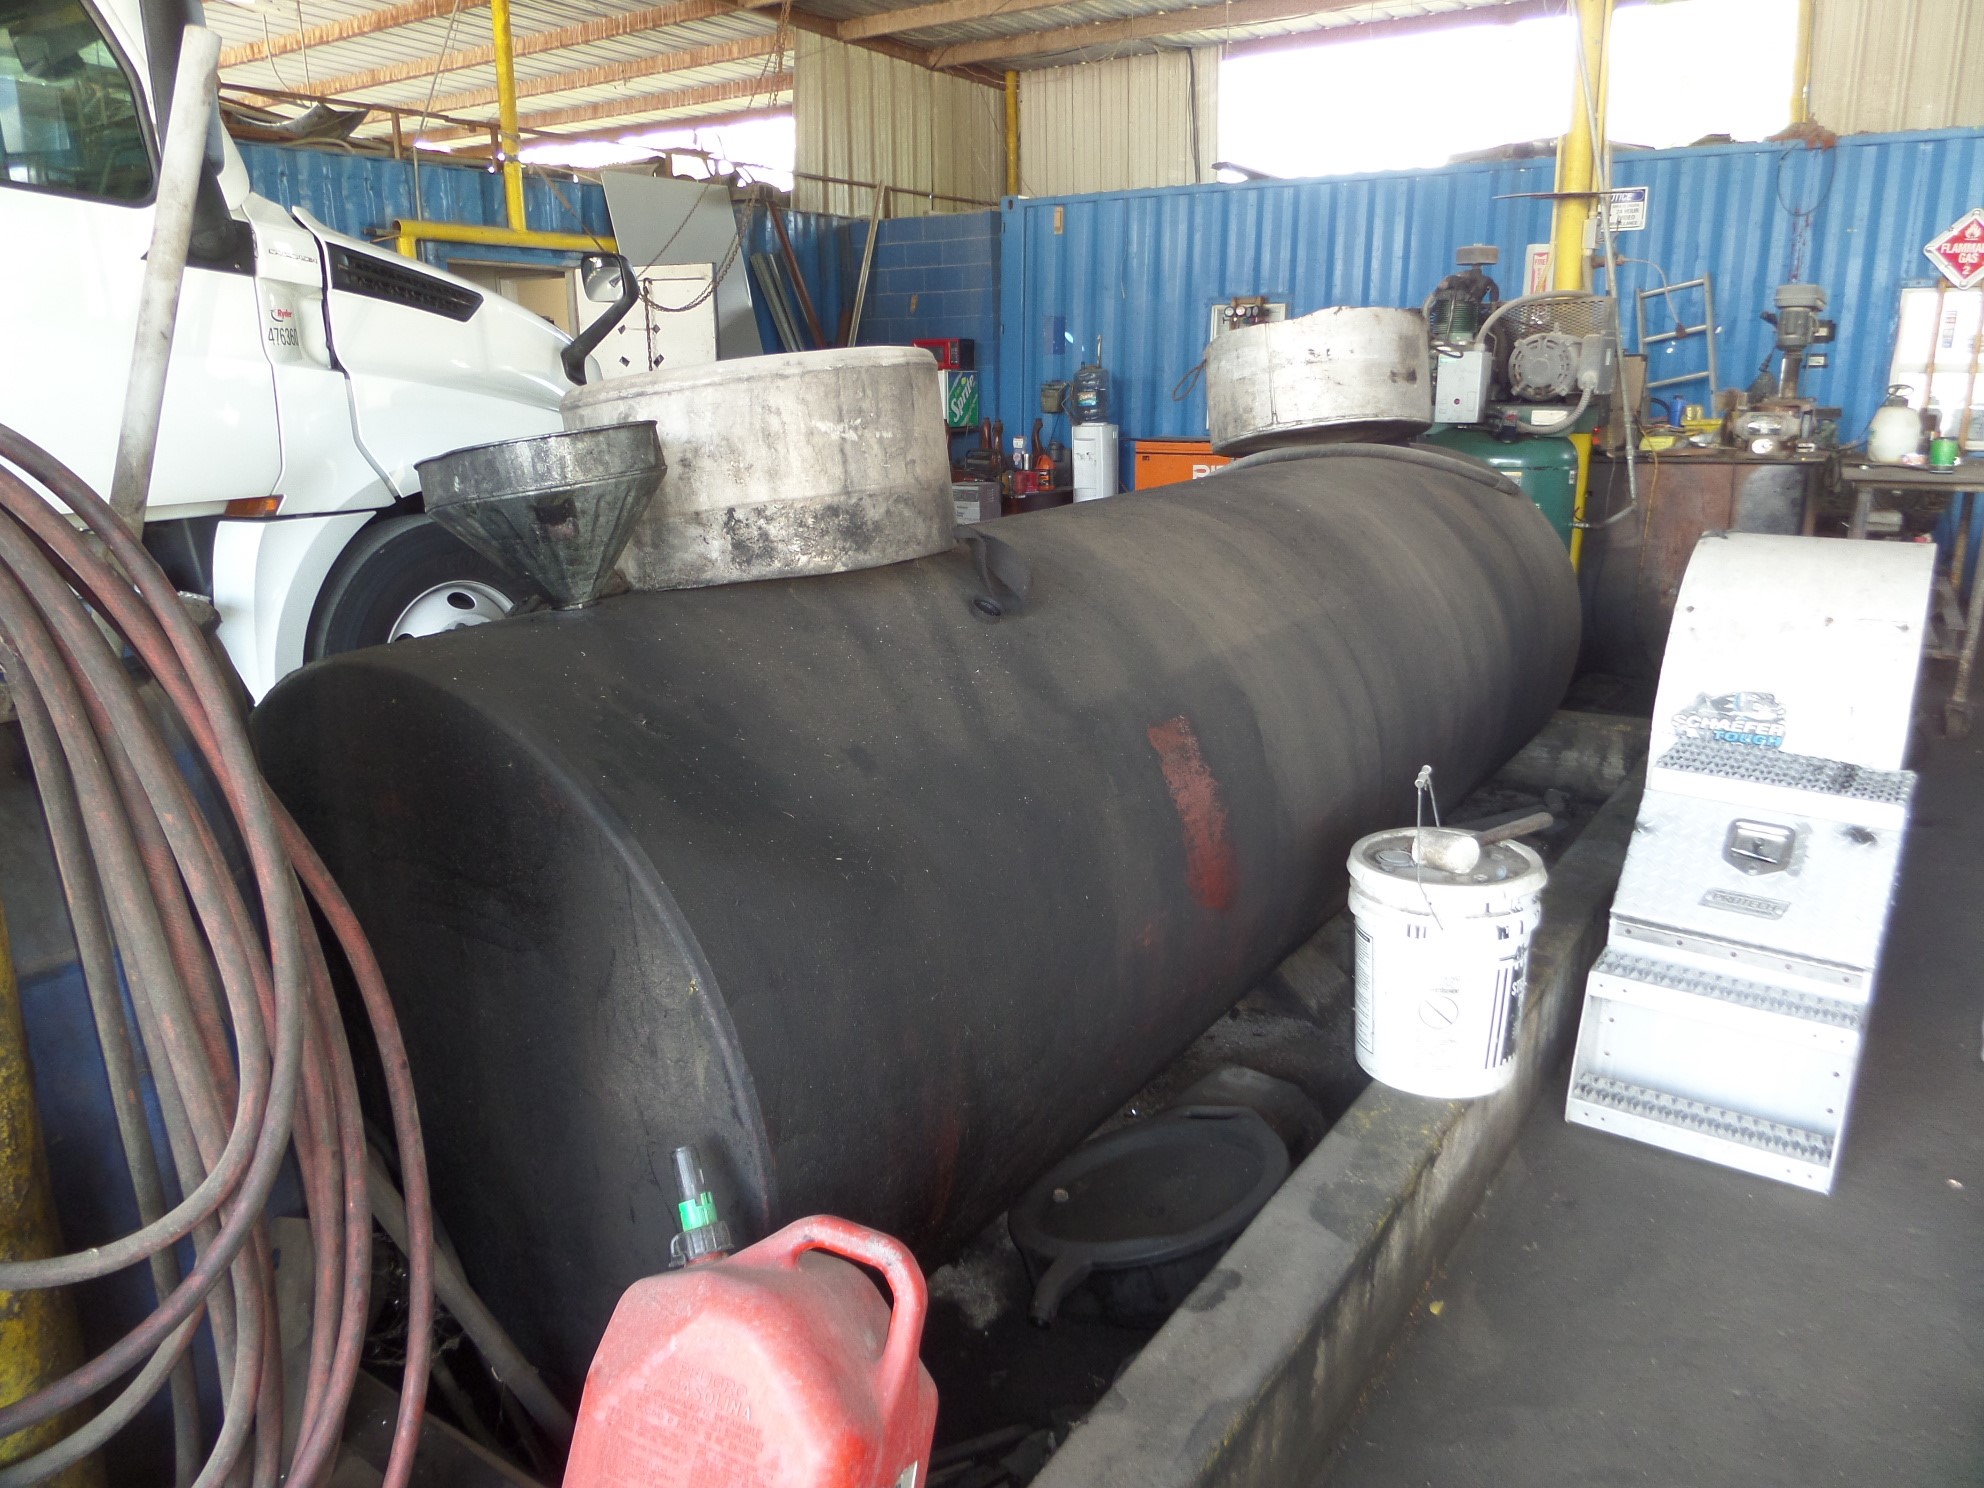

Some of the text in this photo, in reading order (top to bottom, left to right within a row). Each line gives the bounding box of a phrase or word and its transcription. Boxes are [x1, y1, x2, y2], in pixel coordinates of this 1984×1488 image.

[1610, 193, 1632, 202] OTICE
[1958, 253, 1979, 264] GAS
[1962, 265, 1971, 275] 2
[277, 308, 293, 319] Ryder
[950, 374, 975, 423] Sprite
[1671, 714, 1785, 736] SCHAEFER
[1713, 729, 1782, 748] TOUGH
